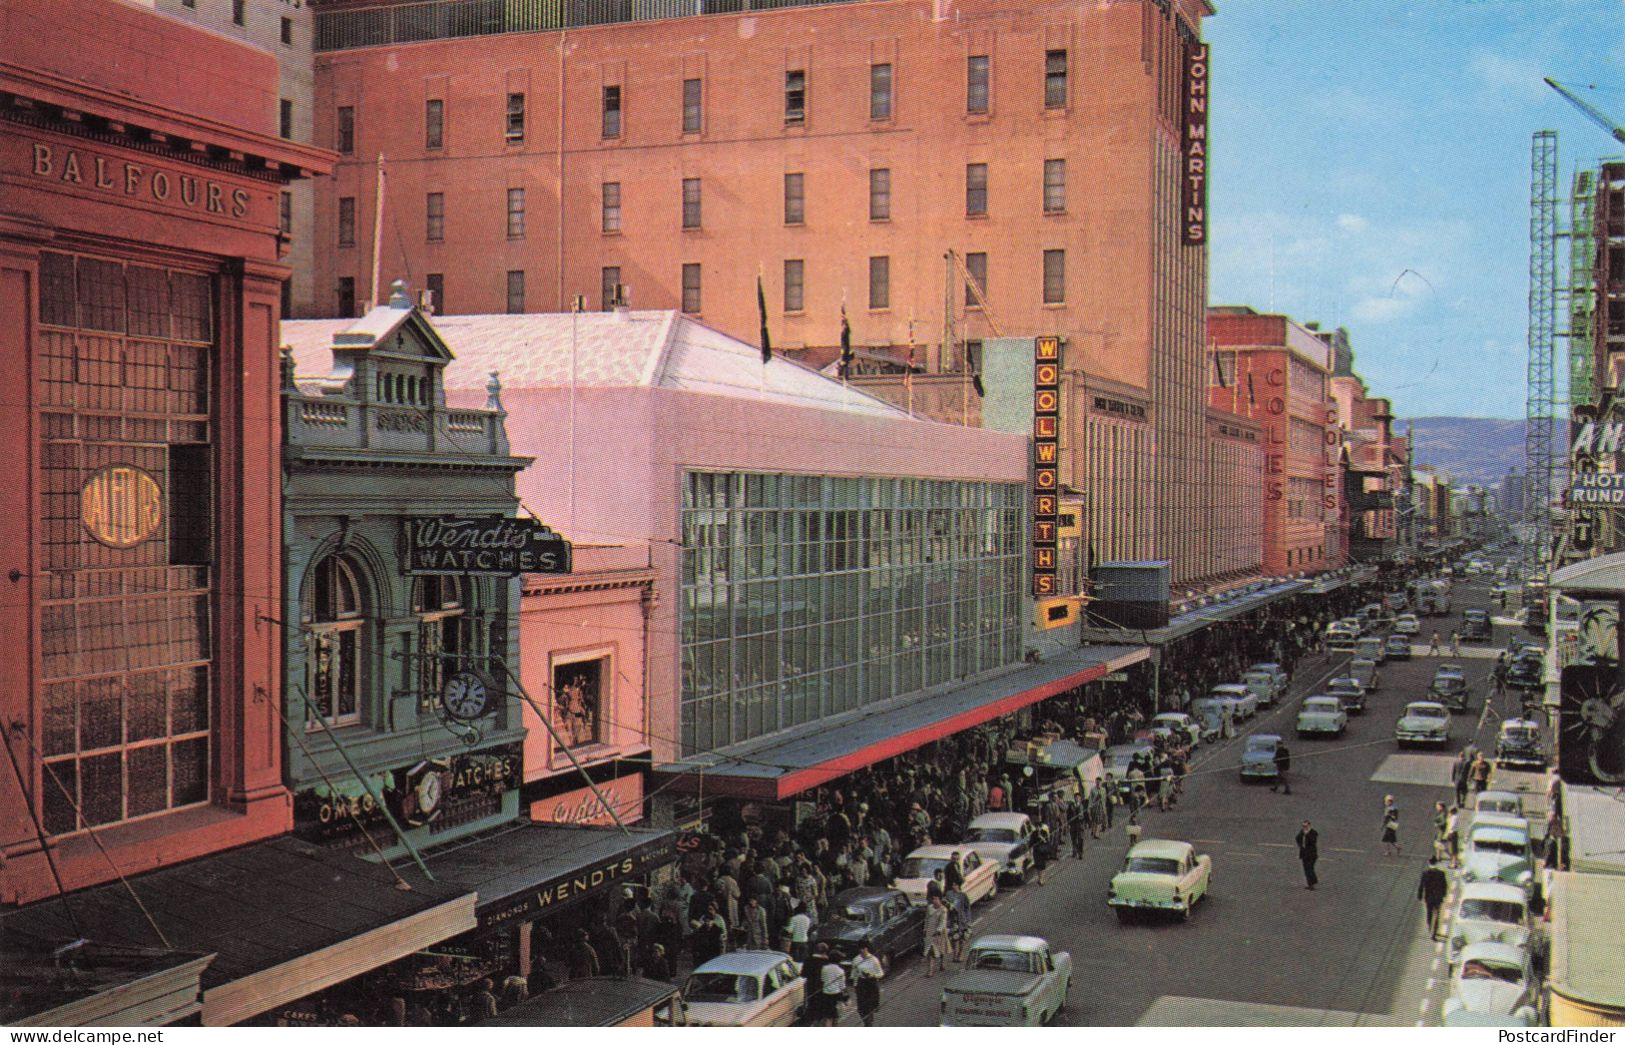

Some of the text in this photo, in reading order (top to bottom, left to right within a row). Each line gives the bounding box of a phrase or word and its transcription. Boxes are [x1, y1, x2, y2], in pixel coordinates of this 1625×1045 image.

[32, 142, 251, 218] BALFOURS
[1187, 46, 1207, 240] JOHN MARTINS
[1038, 340, 1056, 592] WOOLWORTHS
[1266, 368, 1285, 501] COLES
[1325, 409, 1337, 510] COLES
[419, 550, 558, 570] WATCHES
[320, 792, 380, 823] OMEG
[449, 759, 511, 789] ATCHES
[537, 857, 634, 907] WENDTS
